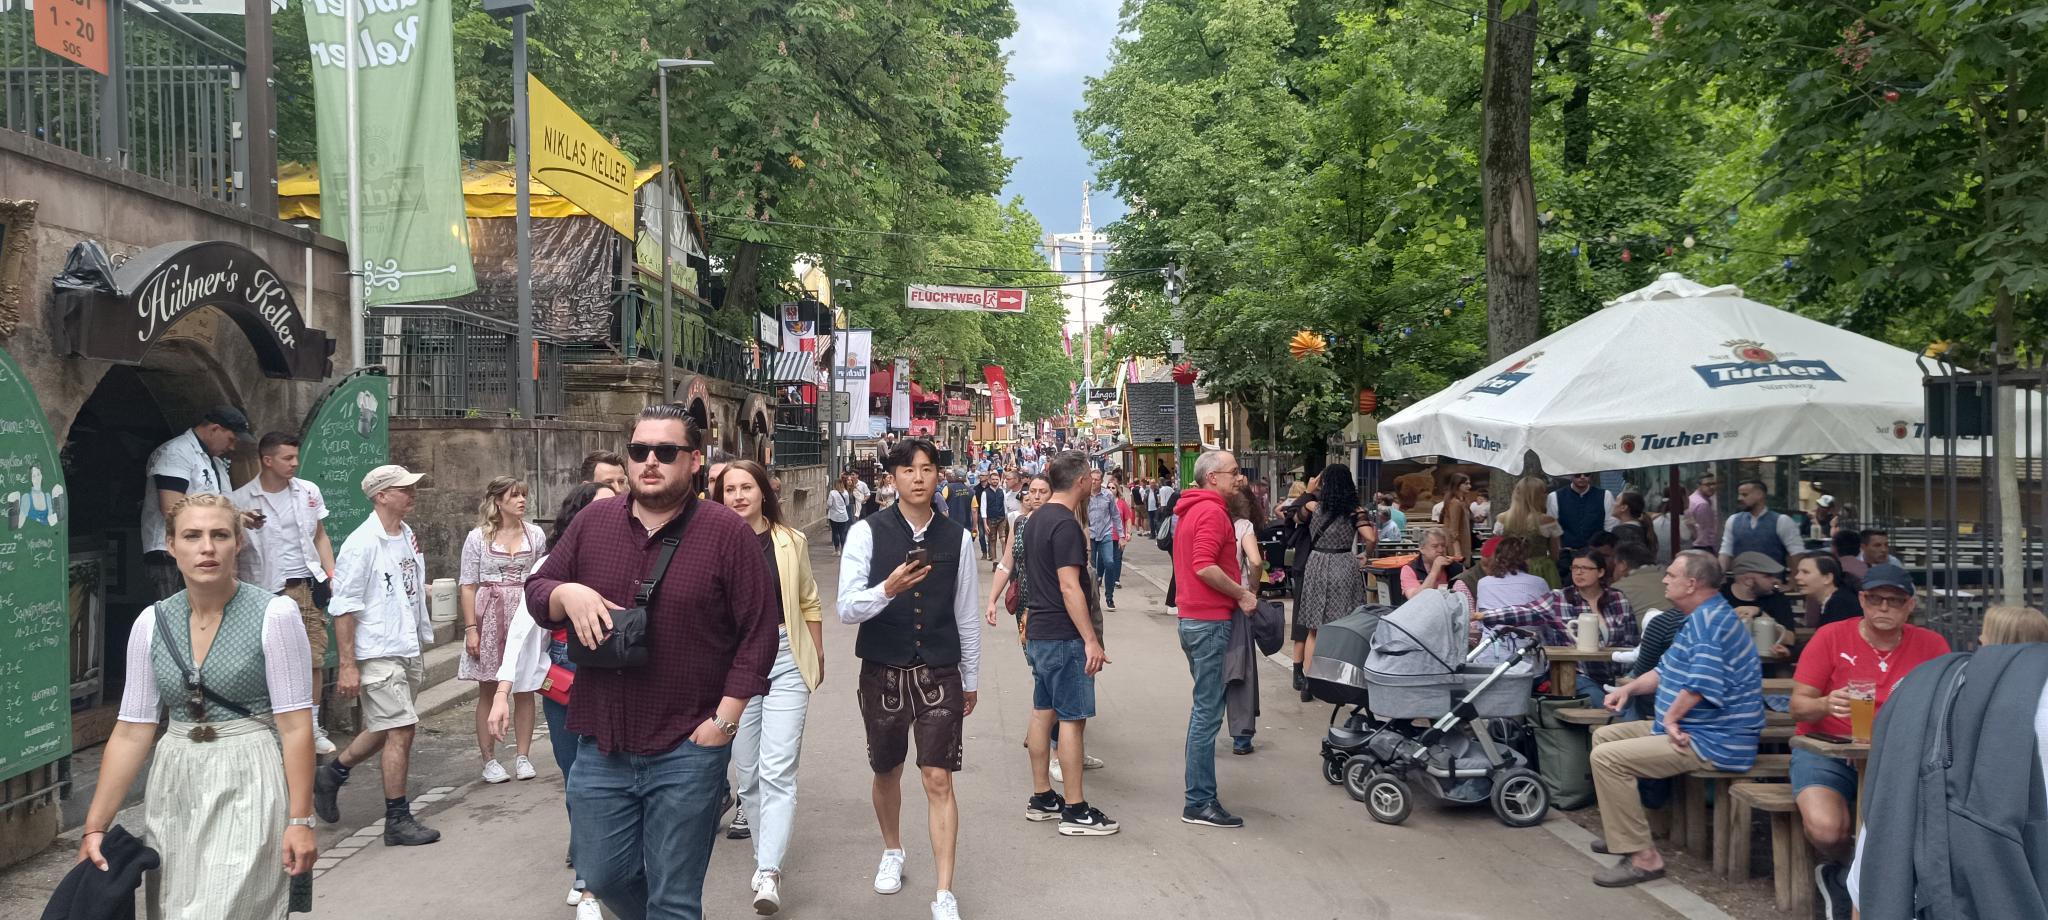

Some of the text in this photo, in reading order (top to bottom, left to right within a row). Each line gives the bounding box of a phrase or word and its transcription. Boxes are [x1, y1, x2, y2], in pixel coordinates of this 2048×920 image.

[49, 6, 58, 26] 1
[76, 17, 94, 42] 20
[62, 40, 82, 57] SOS
[544, 125, 627, 186] NIKLAS KELLER
[138, 259, 239, 342] Hübner's
[246, 269, 296, 349] Keller
[911, 291, 982, 304] FLUCHTWEG
[1710, 363, 1826, 382] Tucher
[1473, 433, 1501, 452] Tucher
[1640, 431, 1719, 451] Tucher
